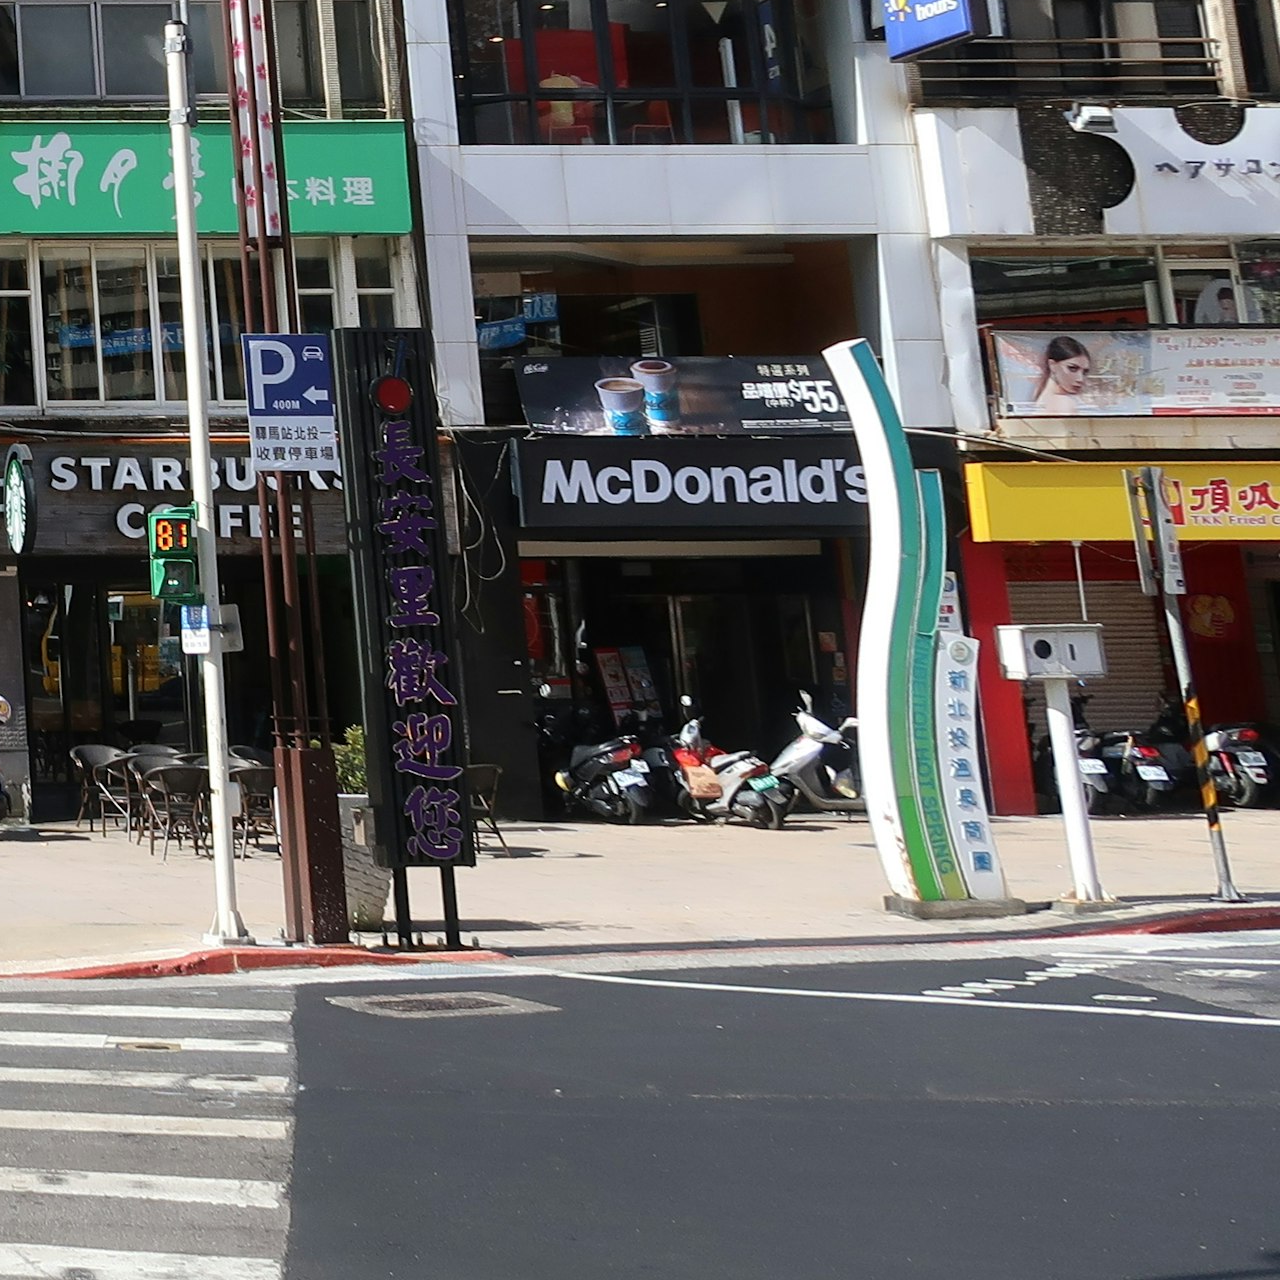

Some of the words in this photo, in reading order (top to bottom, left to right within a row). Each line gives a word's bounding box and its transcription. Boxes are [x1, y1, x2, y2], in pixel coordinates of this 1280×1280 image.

[248, 339, 296, 410] P
[272, 400, 300, 410] 400M
[256, 446, 334, 461] 收費停車場
[50, 456, 344, 492] STARBU
[542, 459, 870, 505] McDonald's
[116, 503, 304, 539] CFE
[156, 520, 189, 551] 81
[1191, 515, 1223, 525] TKK
[1229, 515, 1266, 525] Fried
[372, 420, 464, 861] 長安里歡迎您
